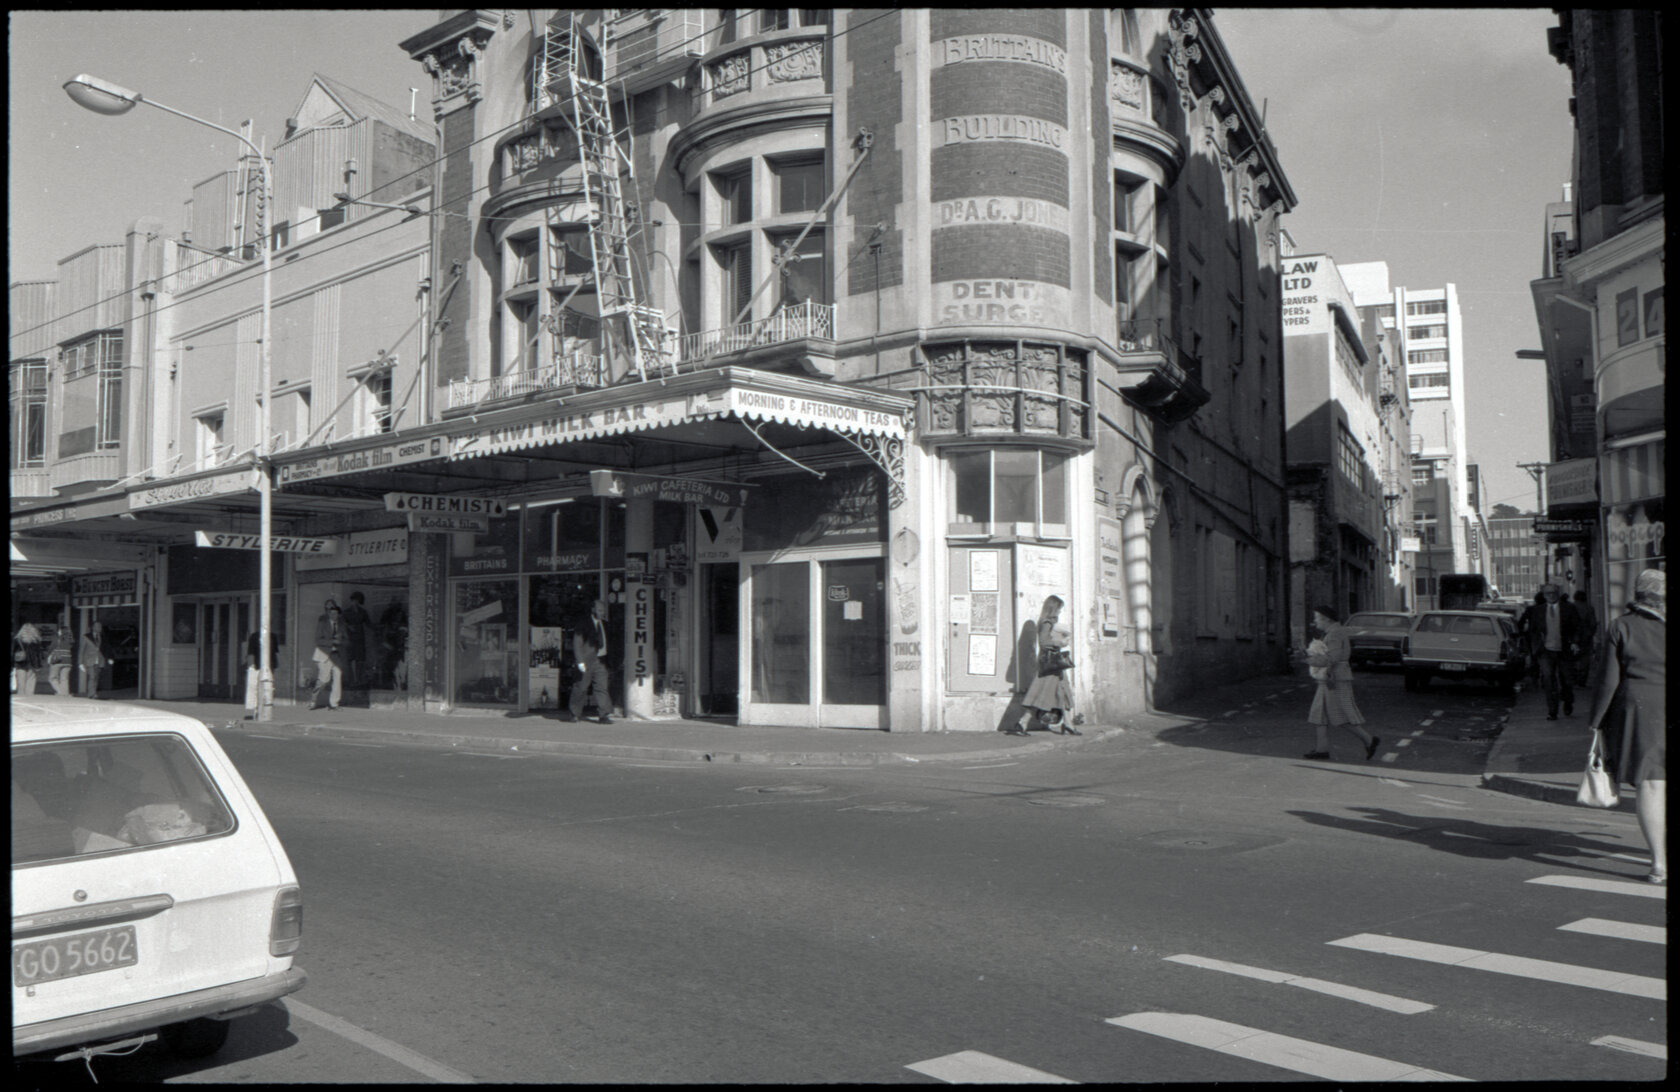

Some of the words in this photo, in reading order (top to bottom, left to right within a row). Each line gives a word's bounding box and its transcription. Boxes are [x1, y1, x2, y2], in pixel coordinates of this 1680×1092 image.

[942, 117, 1062, 149] BUILDING
[1284, 277, 1312, 291] LTD
[738, 391, 785, 411] MORNING
[800, 401, 858, 422] AFTERNOON
[863, 411, 890, 427] TEAS
[488, 423, 535, 445] KIWI
[541, 413, 595, 435] MILK
[602, 403, 648, 426] BAR
[337, 450, 370, 472] Kodak
[371, 447, 393, 466] film
[399, 443, 426, 457] CHEMIST
[632, 481, 658, 497] KIWI
[660, 479, 713, 497] CAFETERIA
[713, 489, 731, 504] LTD
[657, 490, 682, 501] MILK
[683, 492, 704, 504] BAR
[407, 495, 494, 513] CHEMIST
[419, 516, 455, 529] Kodak
[458, 518, 481, 530] film
[212, 533, 326, 553] STYLERITE
[348, 537, 399, 556] STYLERITE
[463, 558, 508, 571] BRITTAINS
[536, 553, 590, 567] PHARMACY
[634, 588, 647, 687] CHEMIST
[893, 640, 921, 657] THICK
[20, 945, 60, 978] GO
[66, 931, 132, 970] 5662
